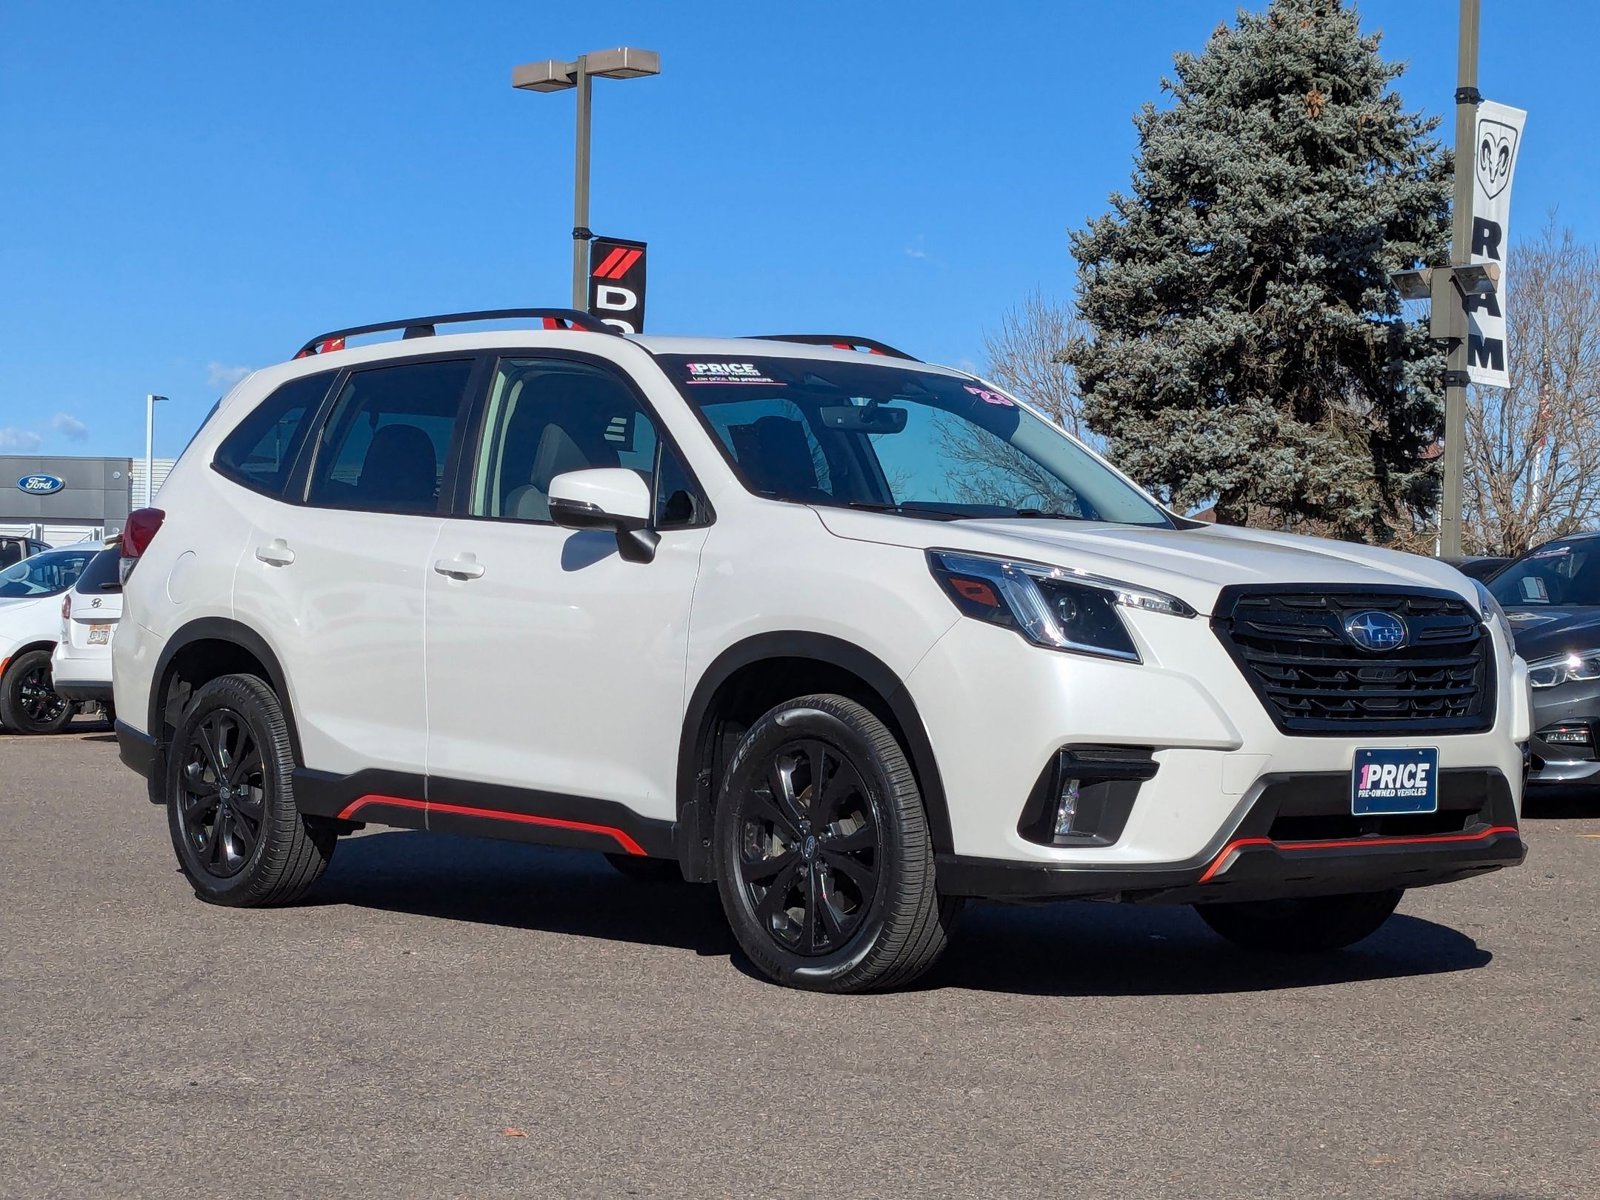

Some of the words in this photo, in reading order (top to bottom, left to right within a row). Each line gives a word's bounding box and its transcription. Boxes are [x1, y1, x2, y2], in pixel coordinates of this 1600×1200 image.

[25, 477, 53, 489] Ford
[1359, 763, 1430, 789] 1PRICE
[1358, 789, 1396, 798] PRE-OWNED
[1397, 788, 1427, 797] VEHICLES
